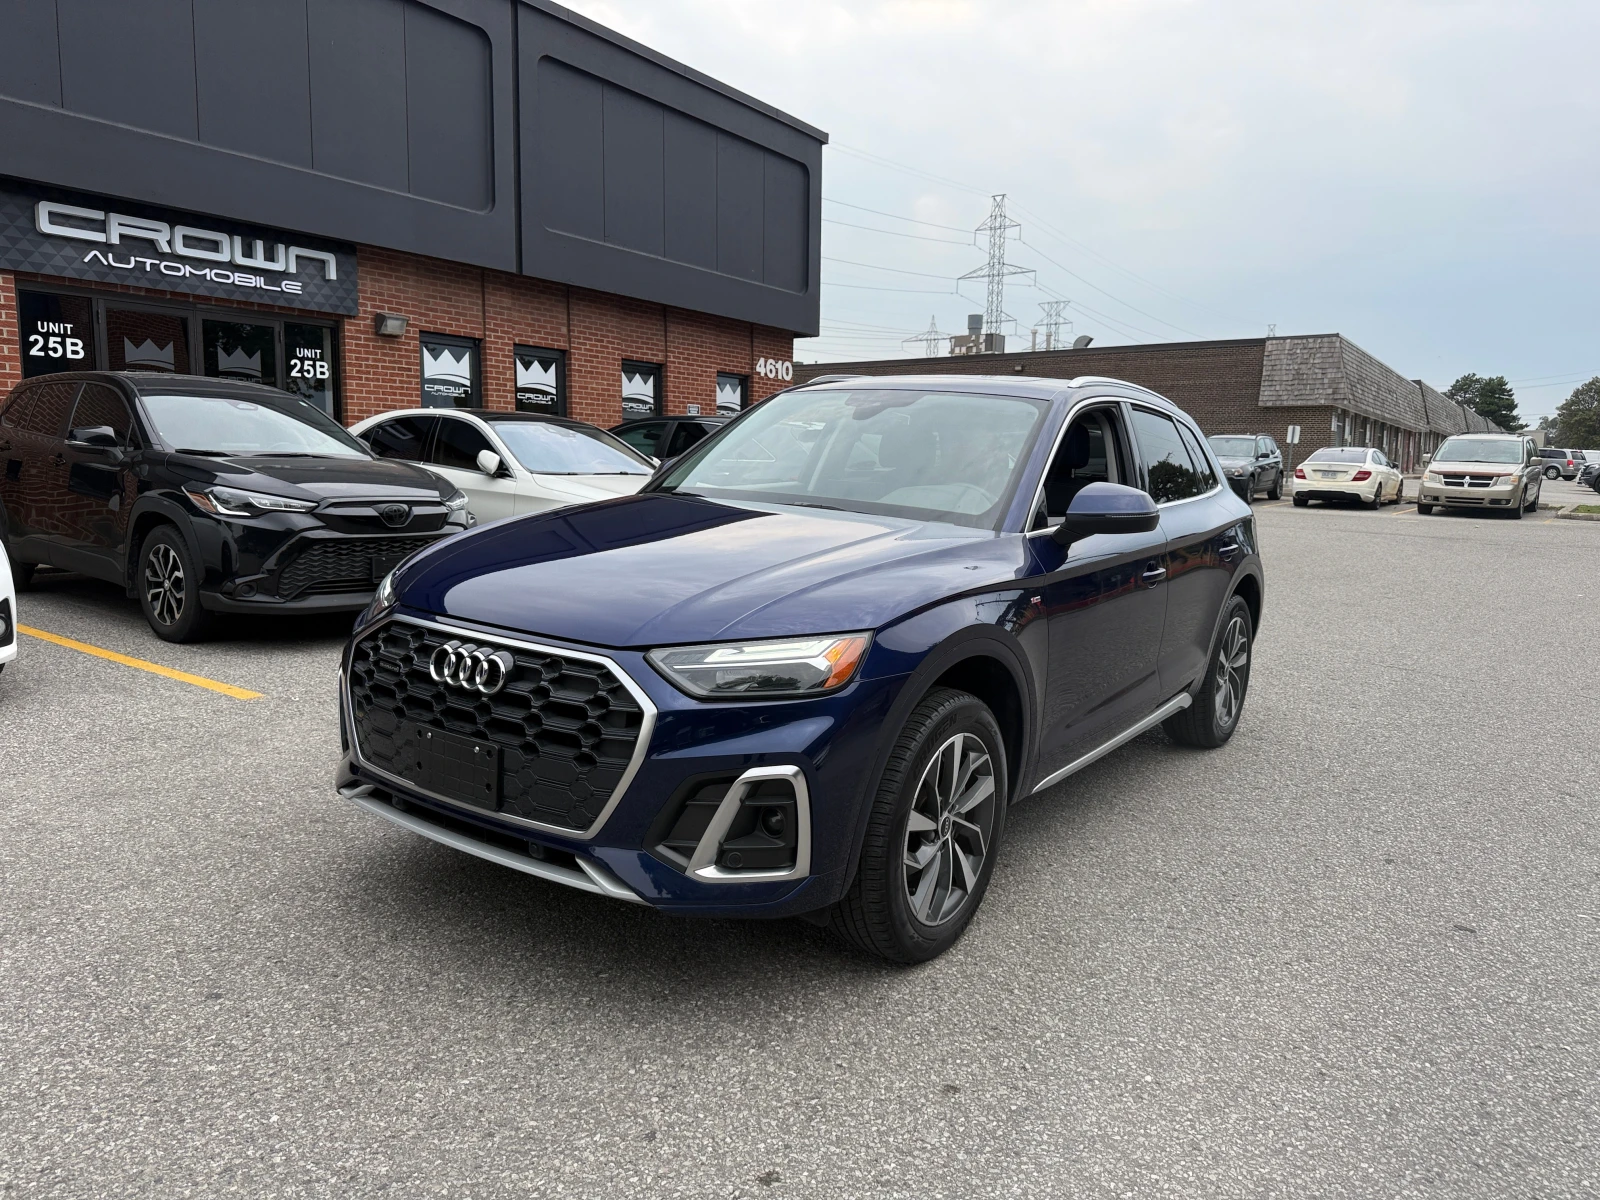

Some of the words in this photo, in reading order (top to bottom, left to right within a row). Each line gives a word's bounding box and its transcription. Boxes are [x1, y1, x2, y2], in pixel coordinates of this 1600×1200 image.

[35, 200, 337, 280] CROWN
[83, 250, 303, 294] AUTOMOBILE
[37, 321, 73, 335] UNIT
[29, 335, 85, 360] 25B
[296, 348, 322, 359] UNIT
[290, 359, 330, 379] 25B
[756, 357, 793, 381] 4610
[424, 384, 471, 394] CROWN
[517, 392, 557, 401] CROWN
[622, 402, 654, 410] CROWN
